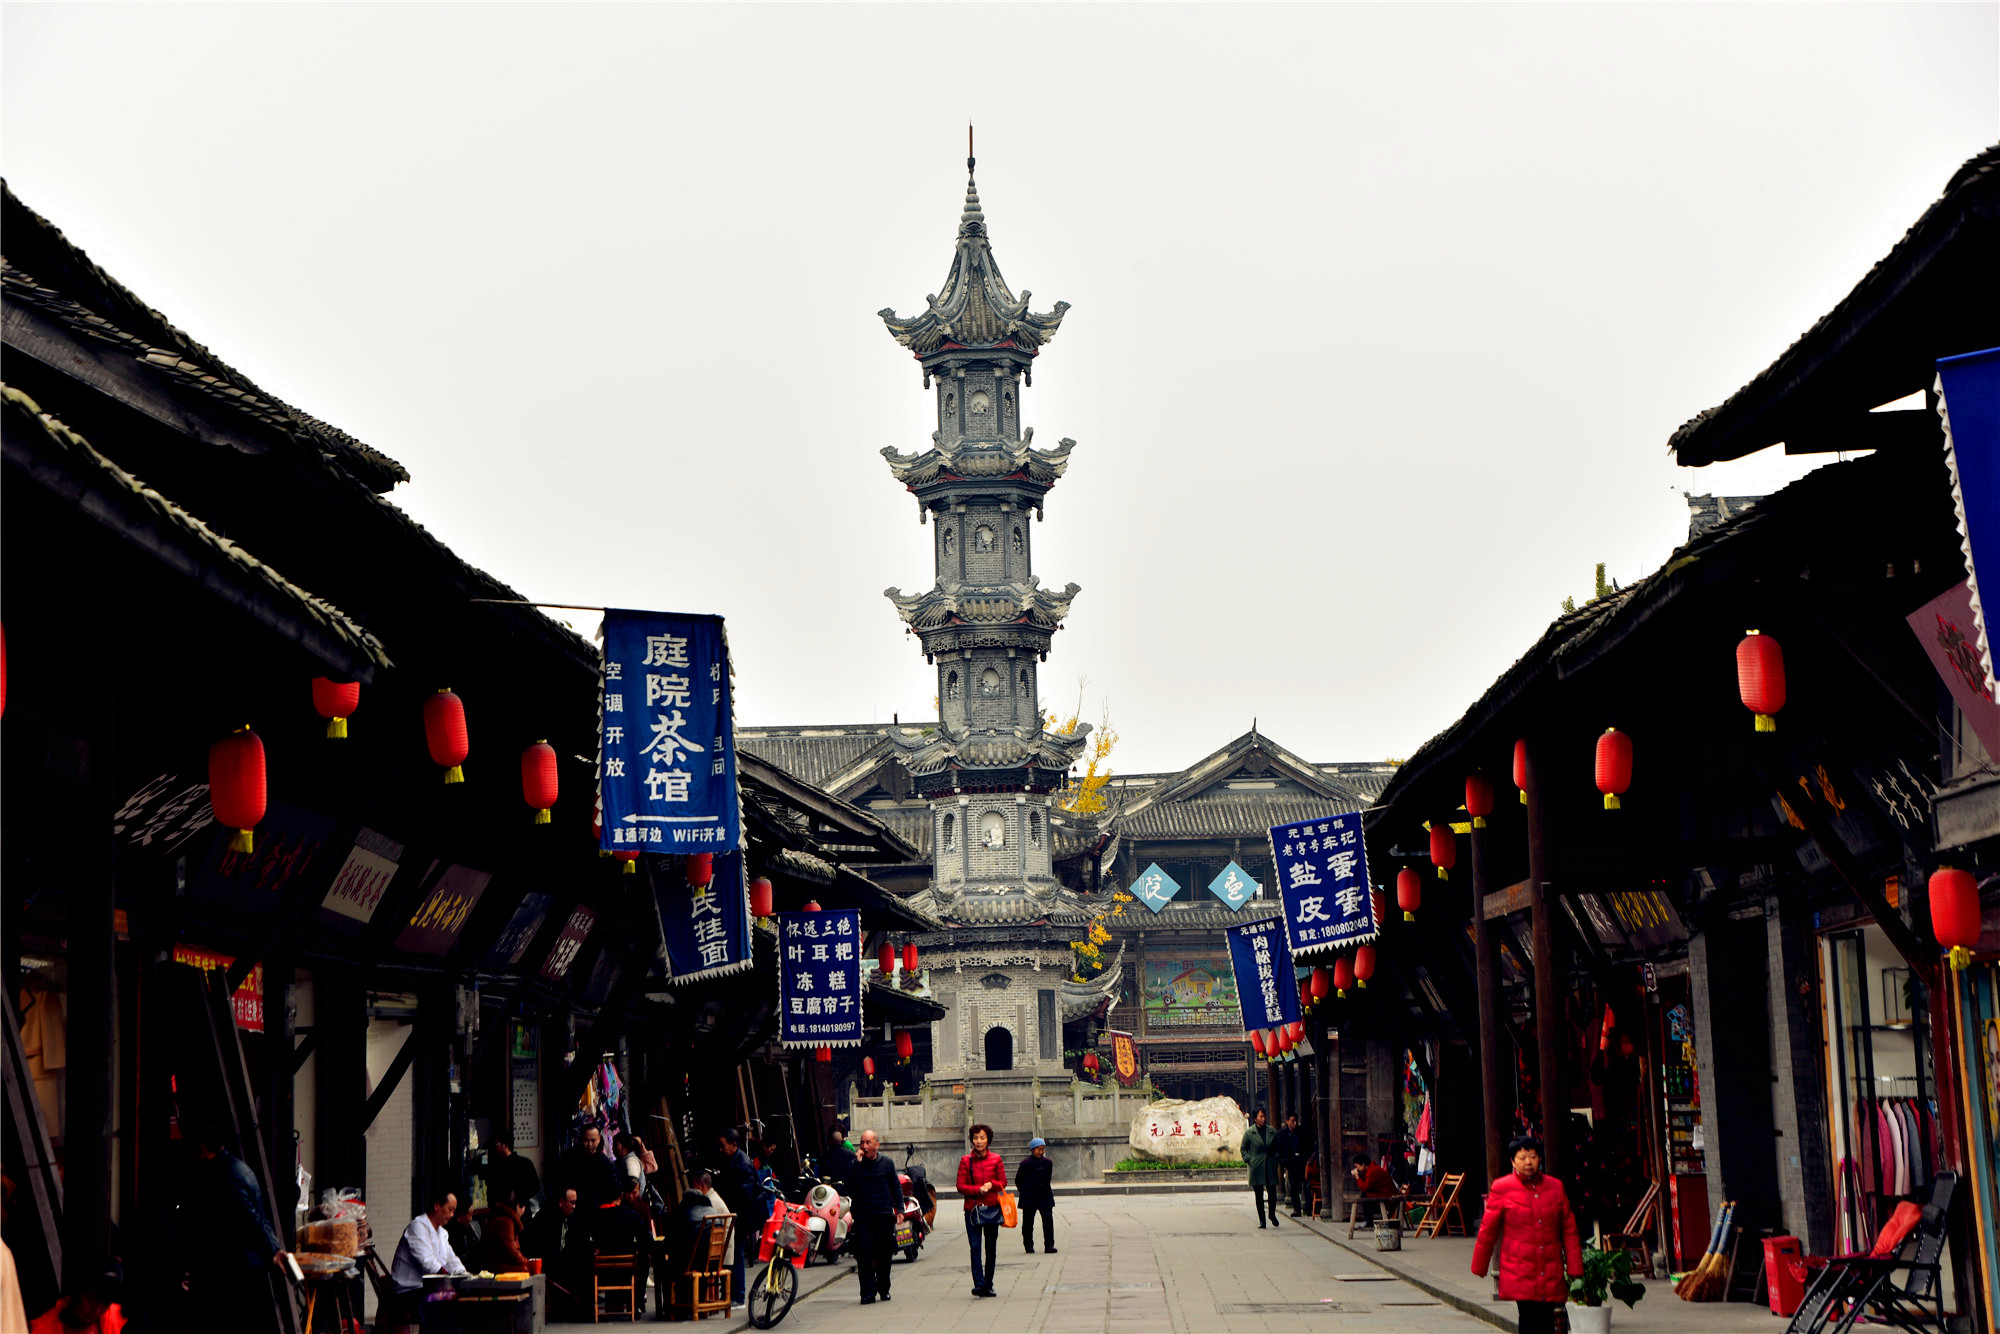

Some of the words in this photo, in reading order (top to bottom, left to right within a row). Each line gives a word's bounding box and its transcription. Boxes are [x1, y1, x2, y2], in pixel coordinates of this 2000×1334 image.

[604, 661, 626, 778] 空调开放
[638, 633, 705, 803] 庭院茶馆
[612, 826, 663, 844] 直通河边
[672, 826, 726, 843] WiFi开放
[1287, 818, 1345, 839] 元通古镇
[1288, 850, 1359, 889] 盐蛋
[1296, 885, 1365, 923] 皮蛋
[785, 916, 853, 939] 怀远三绝
[1240, 920, 1276, 936] 元通古镇
[787, 941, 854, 963] 叶耳粑
[796, 969, 847, 992] 冻糕
[789, 995, 855, 1016] 豆腐帘子
